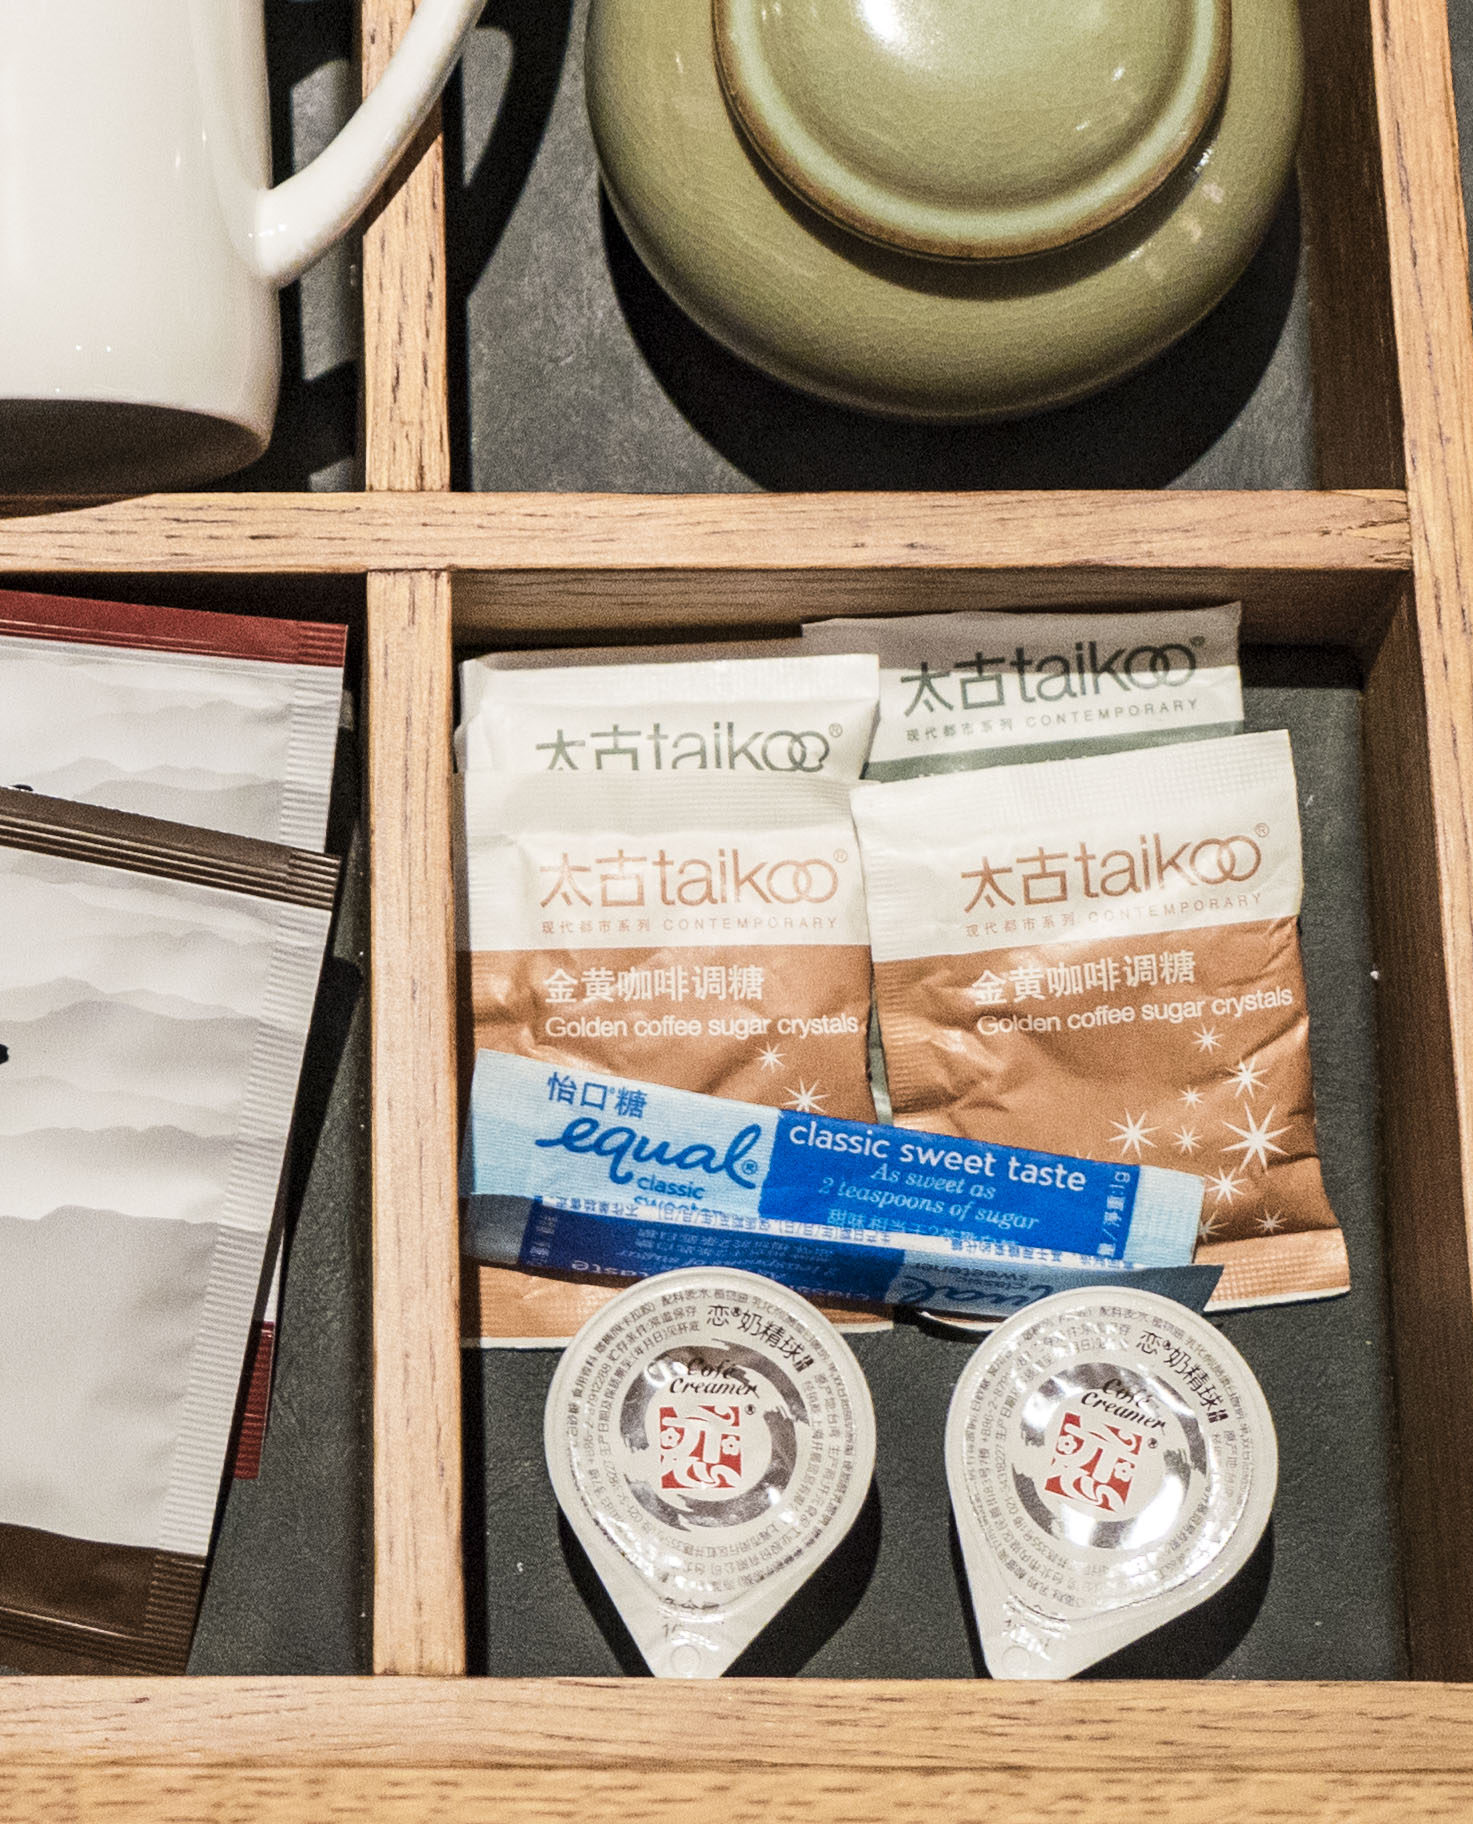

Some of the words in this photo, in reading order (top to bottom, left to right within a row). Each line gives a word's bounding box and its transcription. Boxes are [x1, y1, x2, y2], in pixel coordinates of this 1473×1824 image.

[1026, 698, 1199, 728] CONTEMPORARY
[664, 916, 838, 931] CONTEMPORARY
[1088, 893, 1263, 923] CONTEMPORARY
[543, 965, 764, 1003] 金黄咖啡调糖
[970, 951, 1196, 1005] 金黄咖啡调糖
[546, 1017, 627, 1037] Golden
[634, 1016, 702, 1037] coffee
[708, 1018, 769, 1040] sugar
[777, 1013, 858, 1036] crystals
[977, 1012, 1061, 1038] Golden
[1067, 1004, 1136, 1032] coffee
[1142, 999, 1206, 1026] sugar
[1211, 986, 1293, 1019] crystals
[789, 1121, 890, 1160] classic
[900, 1142, 997, 1178] sweet
[1008, 1155, 1087, 1192] taste
[637, 1175, 705, 1200] classic
[870, 1164, 899, 1183] As
[906, 1171, 965, 1193] sweet
[970, 1183, 997, 1200] as
[818, 1177, 833, 1194] 2
[838, 1180, 945, 1216] teaspoons
[947, 1199, 973, 1225] of
[975, 1207, 1040, 1231] sugar
[669, 1377, 760, 1399] Creamer
[1081, 1391, 1168, 1428] Creamer
